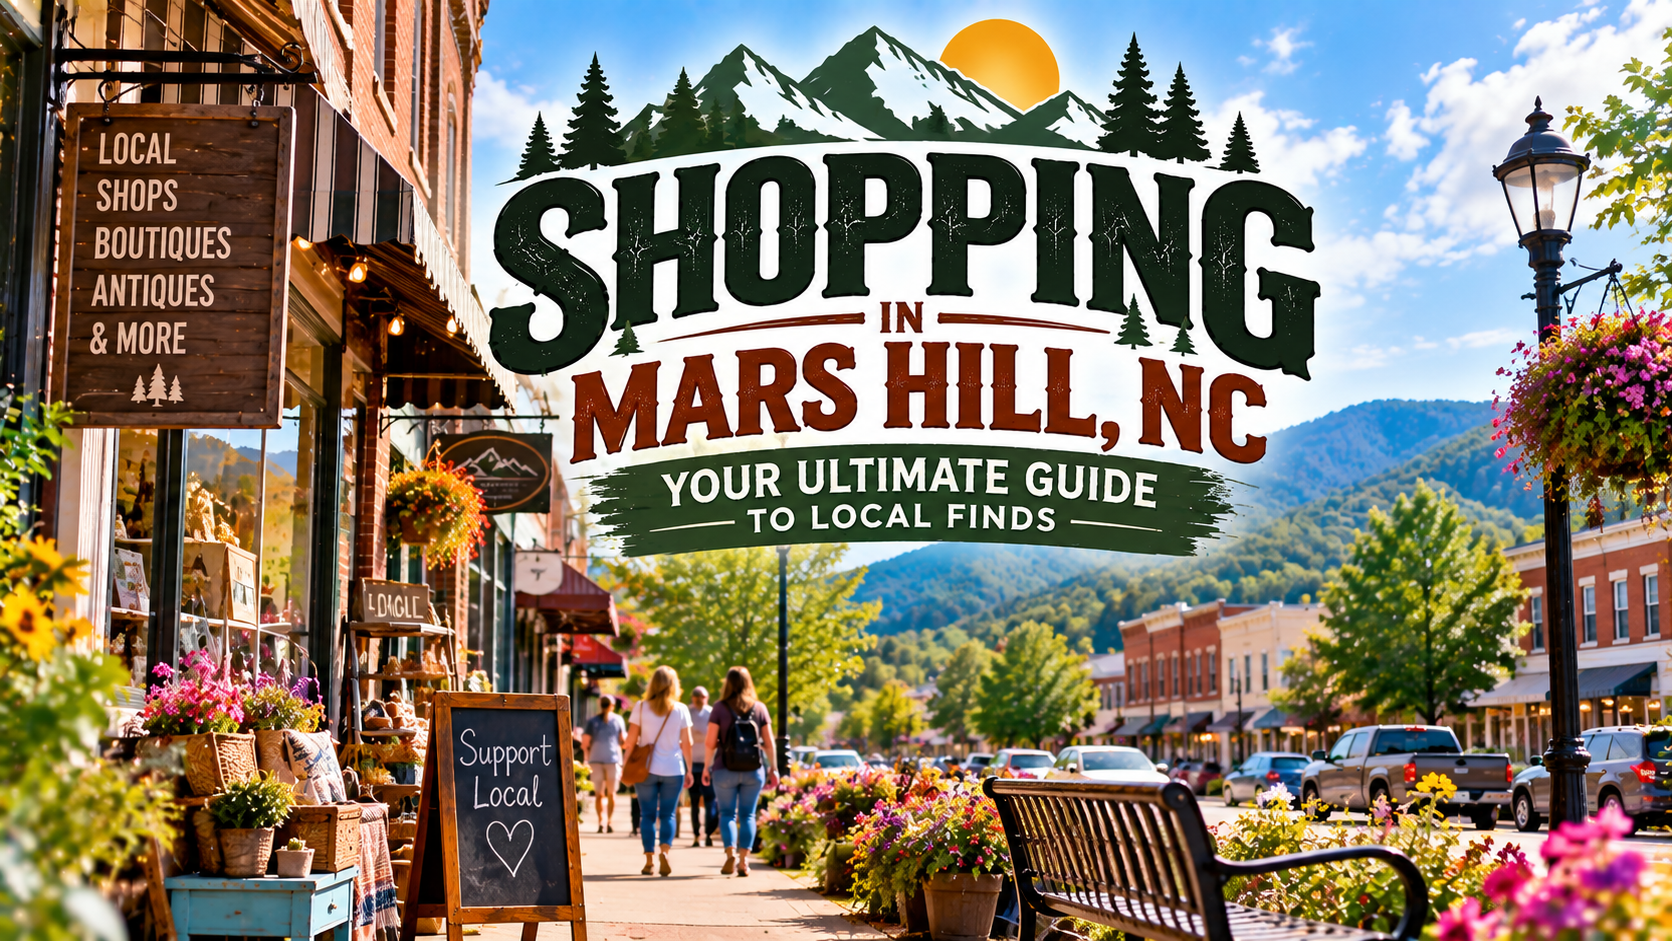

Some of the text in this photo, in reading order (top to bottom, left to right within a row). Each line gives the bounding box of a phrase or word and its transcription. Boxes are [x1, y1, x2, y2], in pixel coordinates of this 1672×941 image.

[98, 132, 177, 165] LOCAL
[96, 178, 178, 212] SHOPS
[94, 226, 232, 262] BOUTIQUES
[91, 273, 215, 310] ANTIQUES
[89, 321, 187, 355] & MORE
[459, 728, 552, 777] Support
[473, 774, 543, 810] Local
